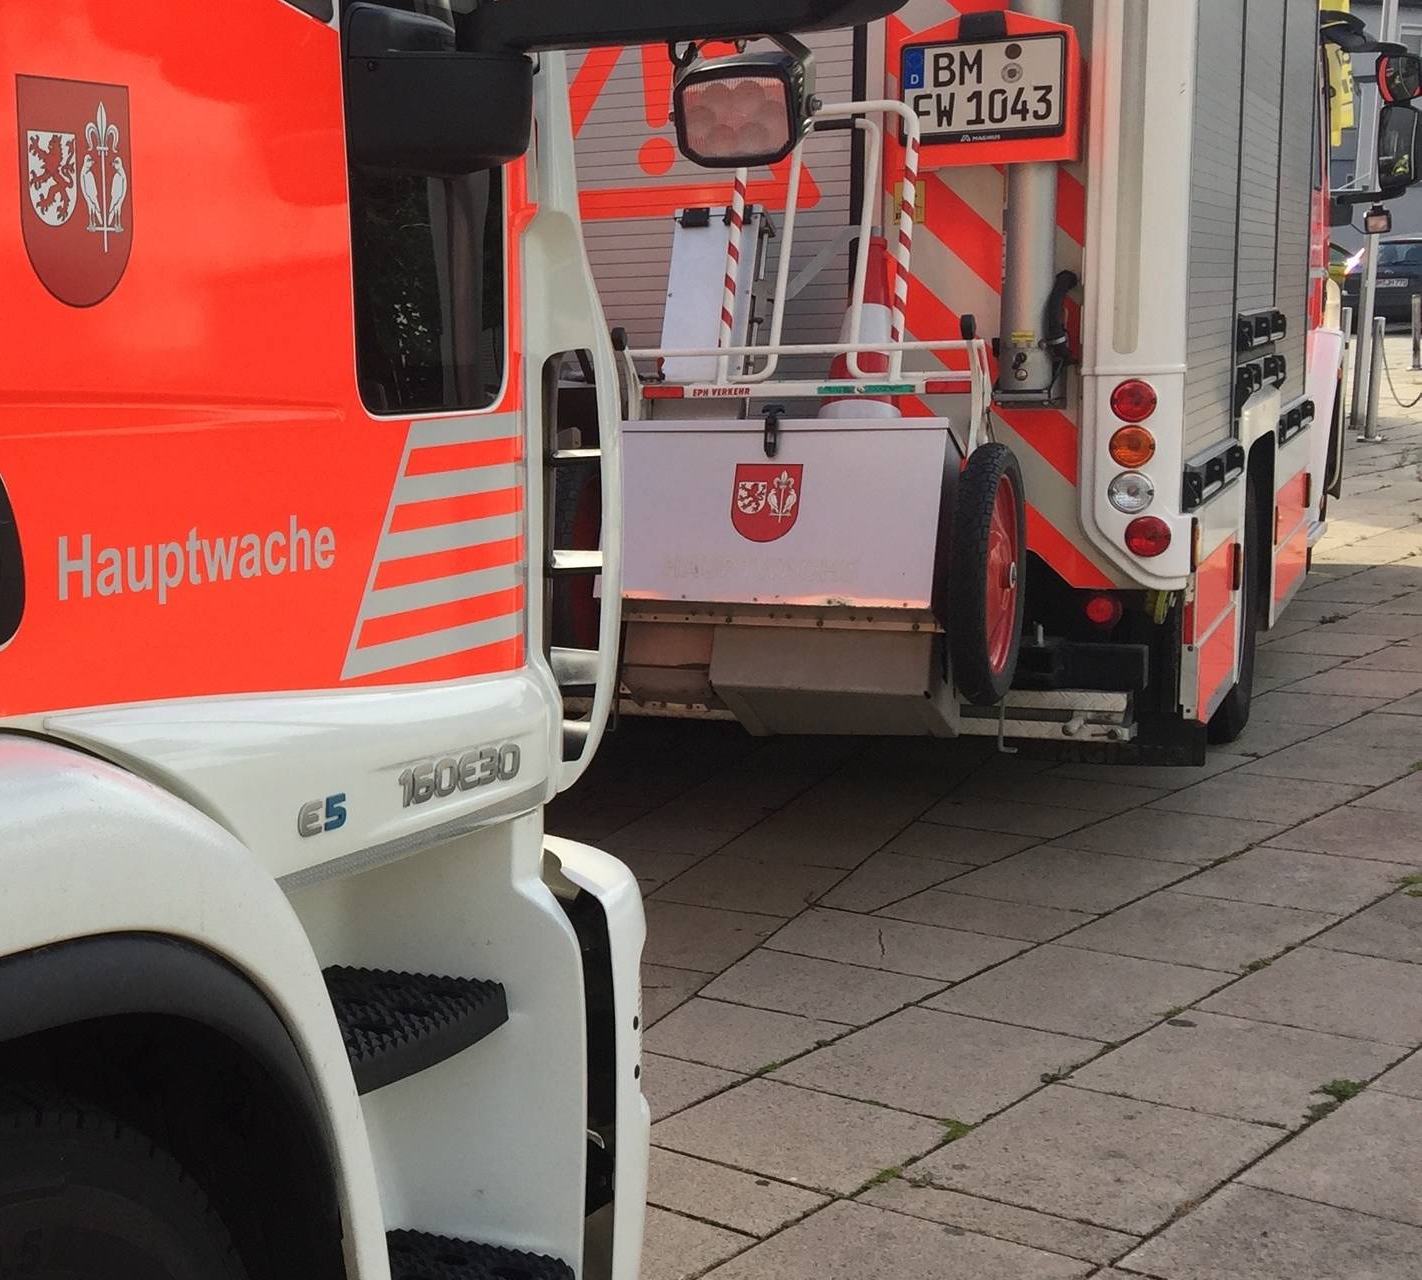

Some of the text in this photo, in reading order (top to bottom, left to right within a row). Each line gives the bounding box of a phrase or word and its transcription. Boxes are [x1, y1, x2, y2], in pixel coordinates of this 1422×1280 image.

[911, 75, 919, 85] D
[932, 49, 983, 88] BM
[913, 85, 1053, 127] FW 1043
[711, 387, 751, 396] VERKEHR
[58, 515, 336, 605] Hauptwache
[398, 743, 521, 808] 160E30
[298, 792, 347, 838] E5
